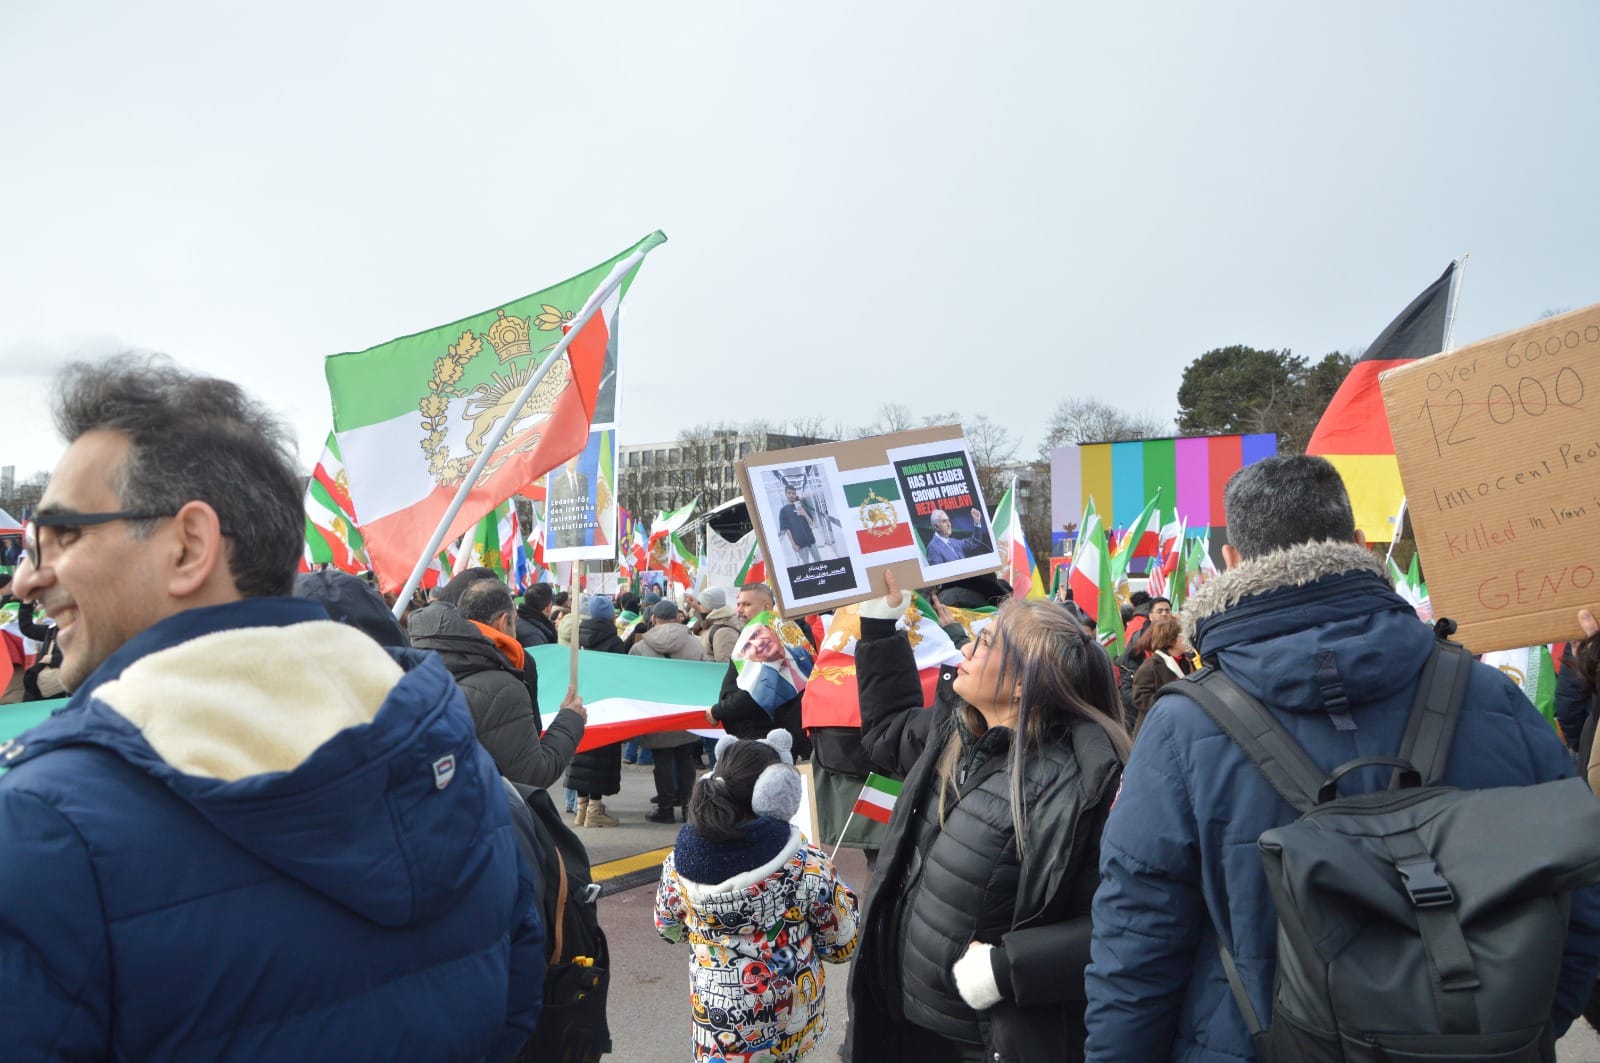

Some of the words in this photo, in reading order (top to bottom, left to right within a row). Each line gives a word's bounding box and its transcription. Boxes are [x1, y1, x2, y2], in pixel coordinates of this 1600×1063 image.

[1505, 326, 1600, 368] 60000
[1417, 388, 1476, 457] 12
[1487, 366, 1584, 425] 000
[902, 463, 928, 476] IRANIAN
[928, 457, 964, 472] REVOLUTION
[907, 475, 926, 489] HAS
[926, 473, 934, 486] A
[933, 468, 965, 484] LEADER
[912, 486, 941, 502] CROWN
[941, 482, 969, 498] PRINCE
[1433, 461, 1551, 513] Innocent
[914, 501, 937, 516] REZA
[938, 494, 973, 510] PAHLAVI
[1528, 513, 1546, 530] in
[1550, 506, 1587, 526] Iran
[1477, 564, 1595, 610] GENO
